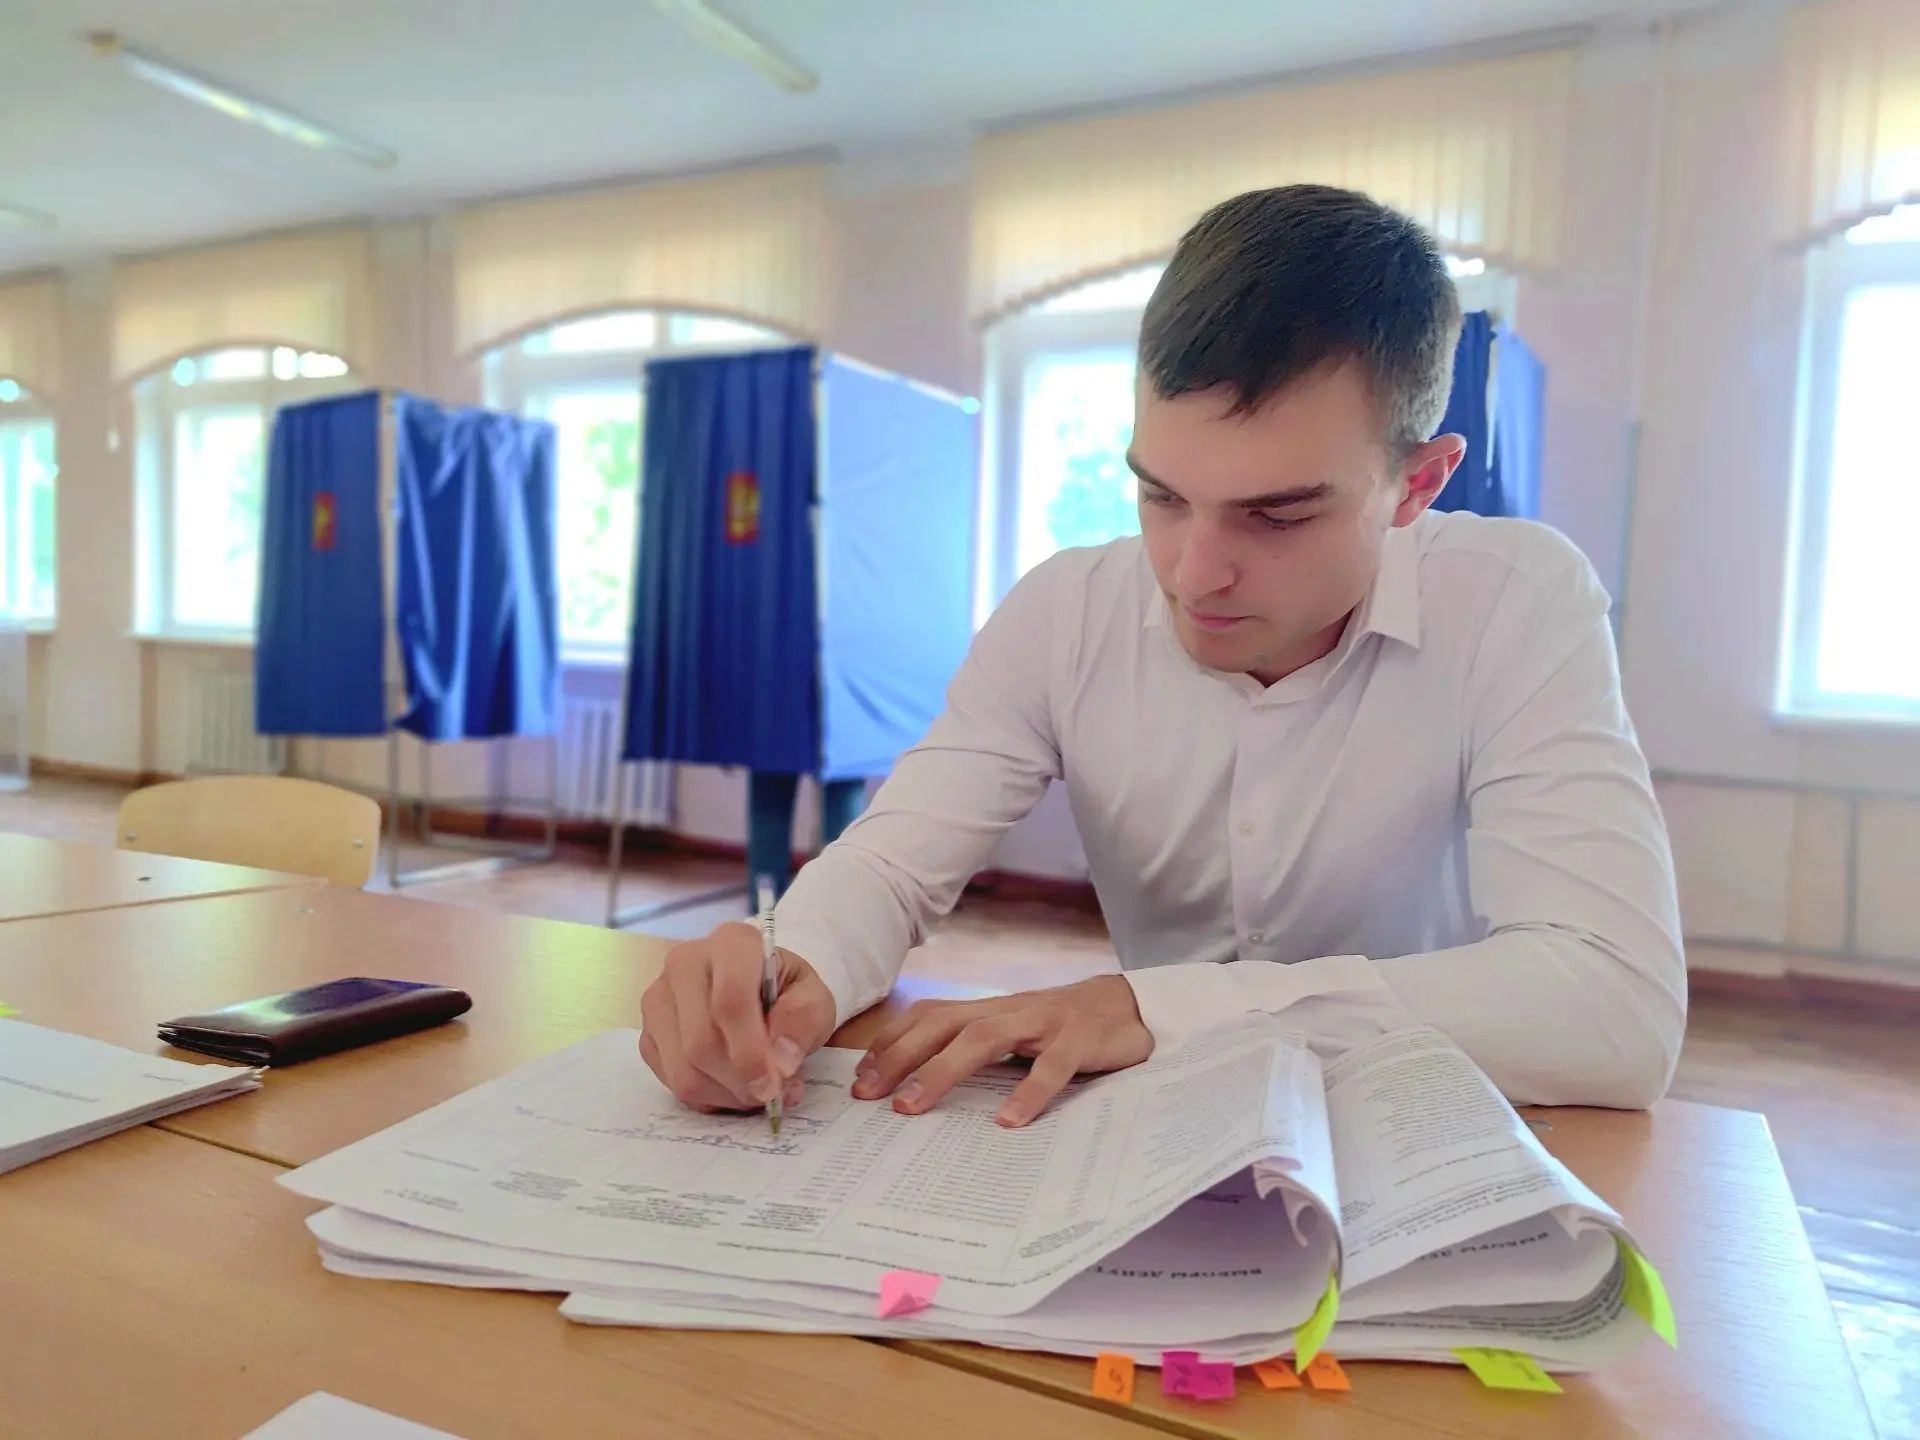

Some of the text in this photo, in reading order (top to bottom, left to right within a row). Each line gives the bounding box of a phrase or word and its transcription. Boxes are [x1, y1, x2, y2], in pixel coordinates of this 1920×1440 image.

[1459, 1231, 1550, 1254] ВЫБОРЫ
[1087, 1264, 1263, 1279] ВЫБОРЫ ДЕПУТ
